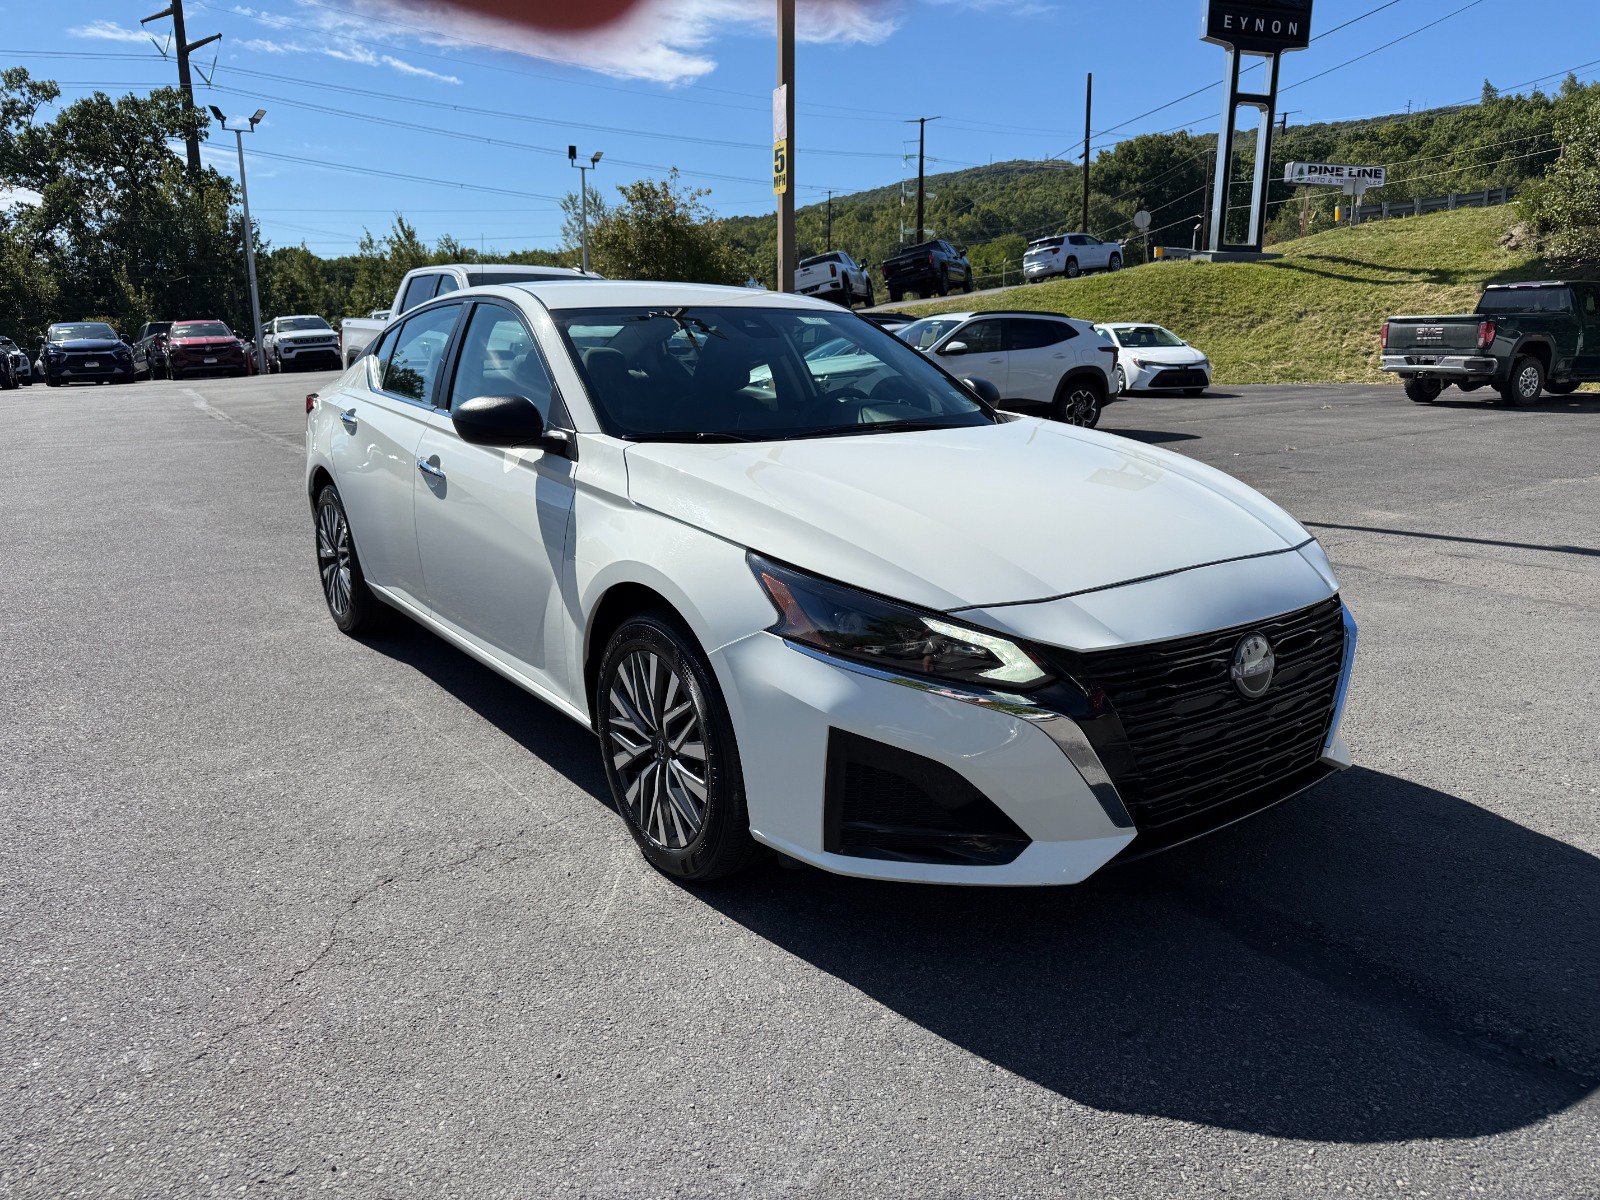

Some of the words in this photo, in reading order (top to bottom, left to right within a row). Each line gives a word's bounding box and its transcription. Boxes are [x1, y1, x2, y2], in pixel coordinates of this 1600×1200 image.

[1223, 14, 1298, 36] EYNON
[774, 147, 785, 173] 5
[773, 173, 786, 188] MPH
[1307, 165, 1344, 177] PINE
[1348, 167, 1383, 179] LINE
[1232, 657, 1273, 677] NISSAN
